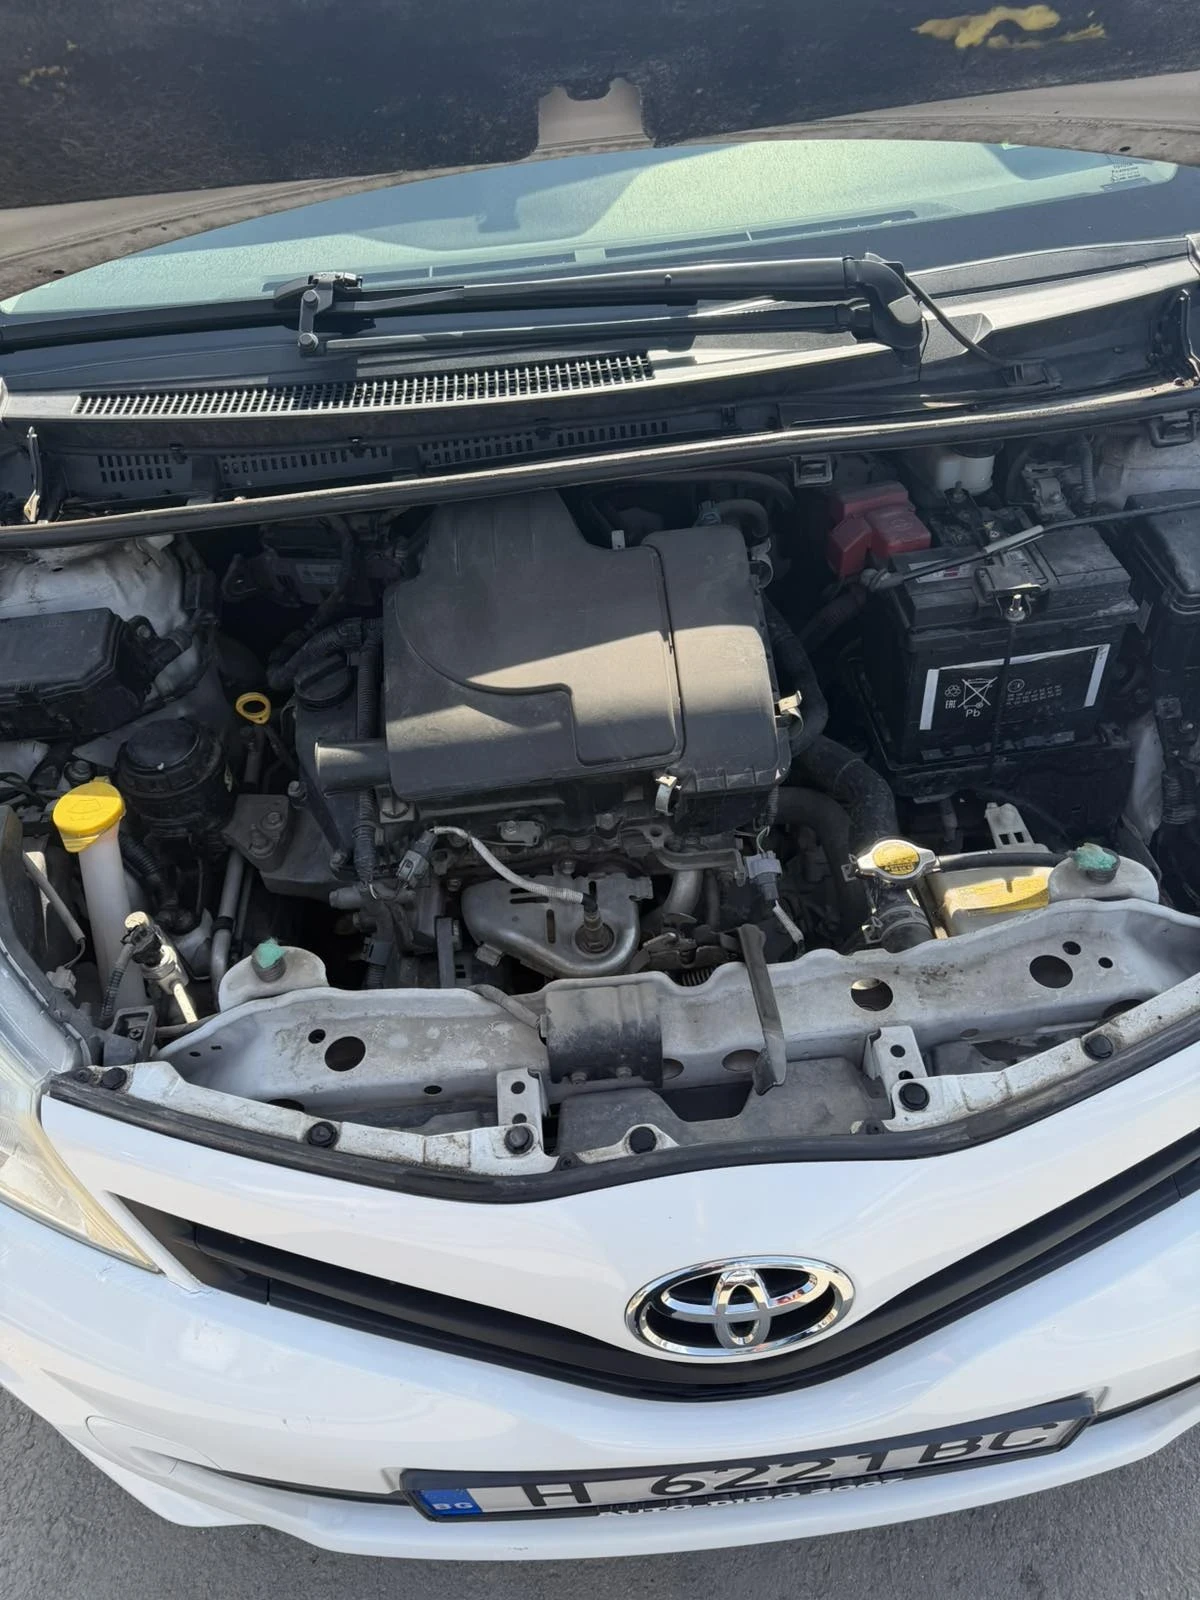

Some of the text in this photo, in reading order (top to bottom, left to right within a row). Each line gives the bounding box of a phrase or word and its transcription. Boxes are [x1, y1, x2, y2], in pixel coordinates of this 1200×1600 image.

[966, 709, 981, 718] Pb
[521, 1422, 1059, 1507] H 6221 BC
[432, 1502, 473, 1511] BG
